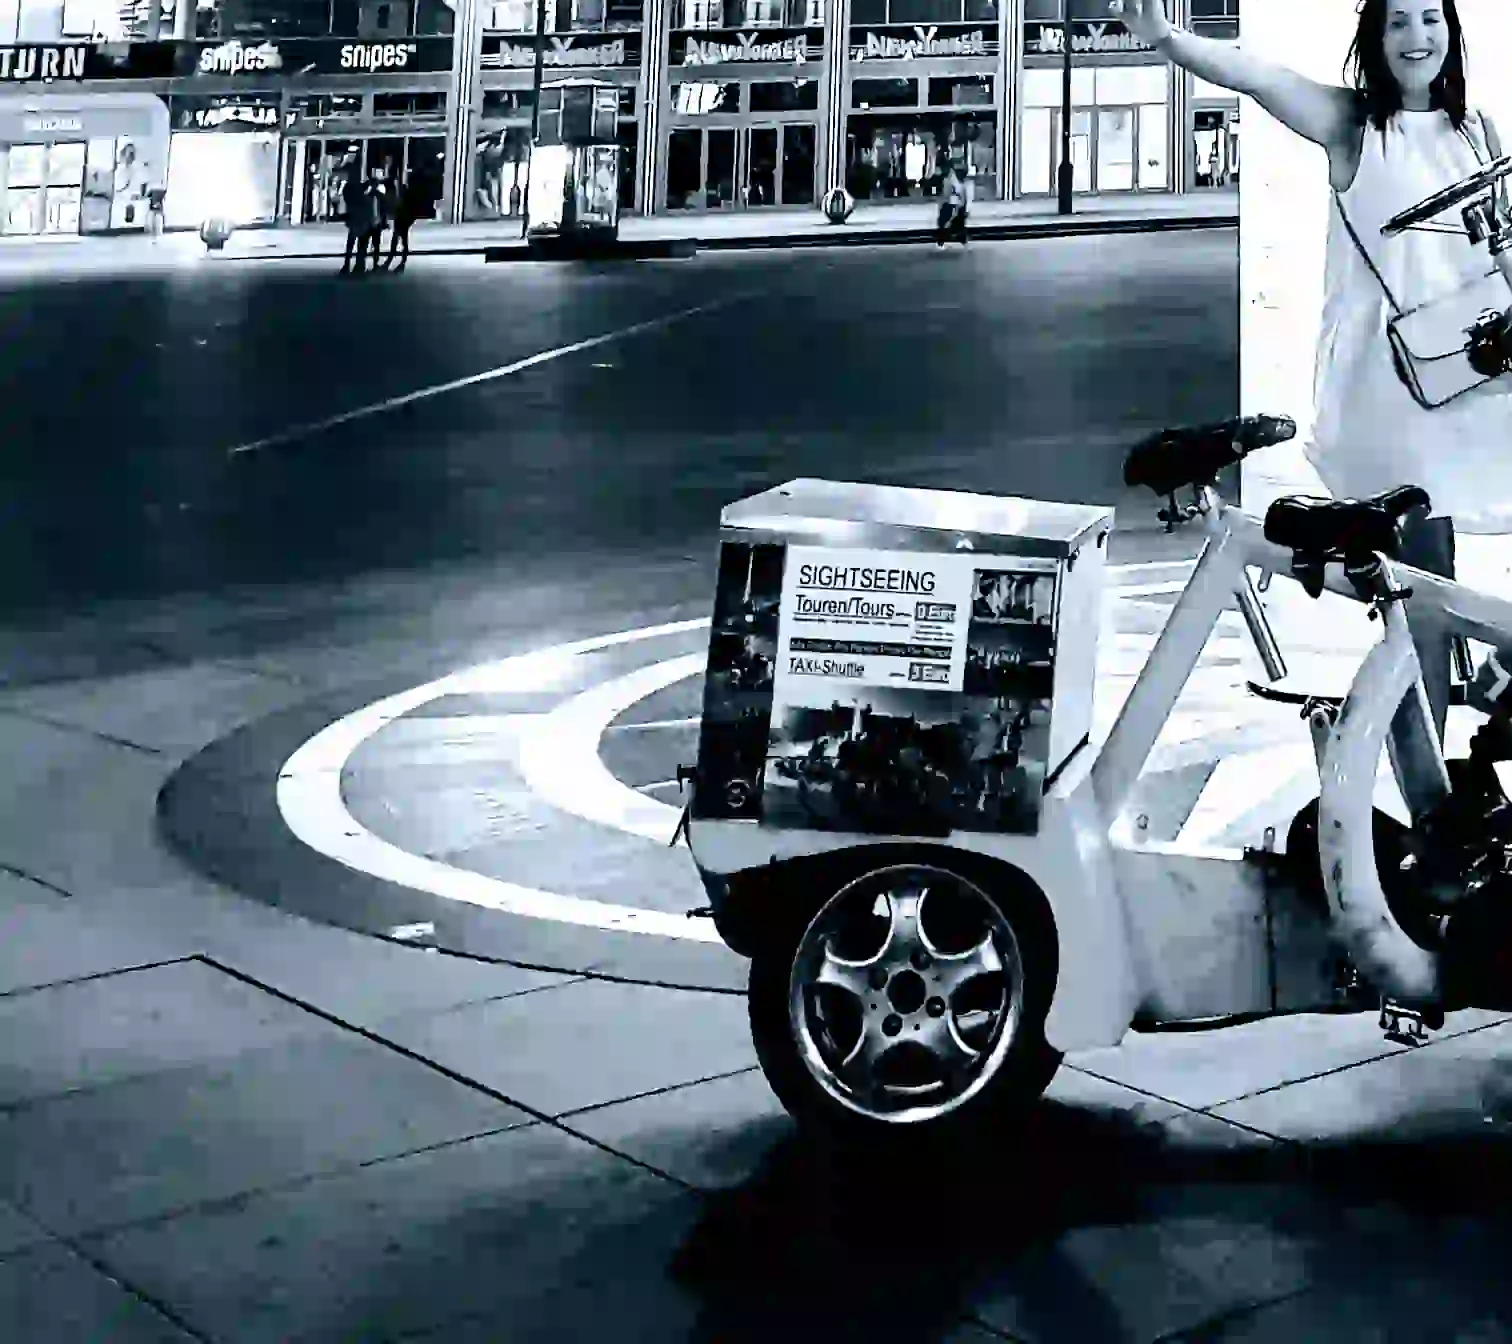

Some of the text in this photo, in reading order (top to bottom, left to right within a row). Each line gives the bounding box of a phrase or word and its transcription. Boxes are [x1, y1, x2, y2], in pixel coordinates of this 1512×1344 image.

[199, 40, 272, 76] snipes
[340, 43, 409, 73] snipes
[799, 563, 936, 592] SIGHTSEEING
[795, 594, 896, 616] Touren/Tours
